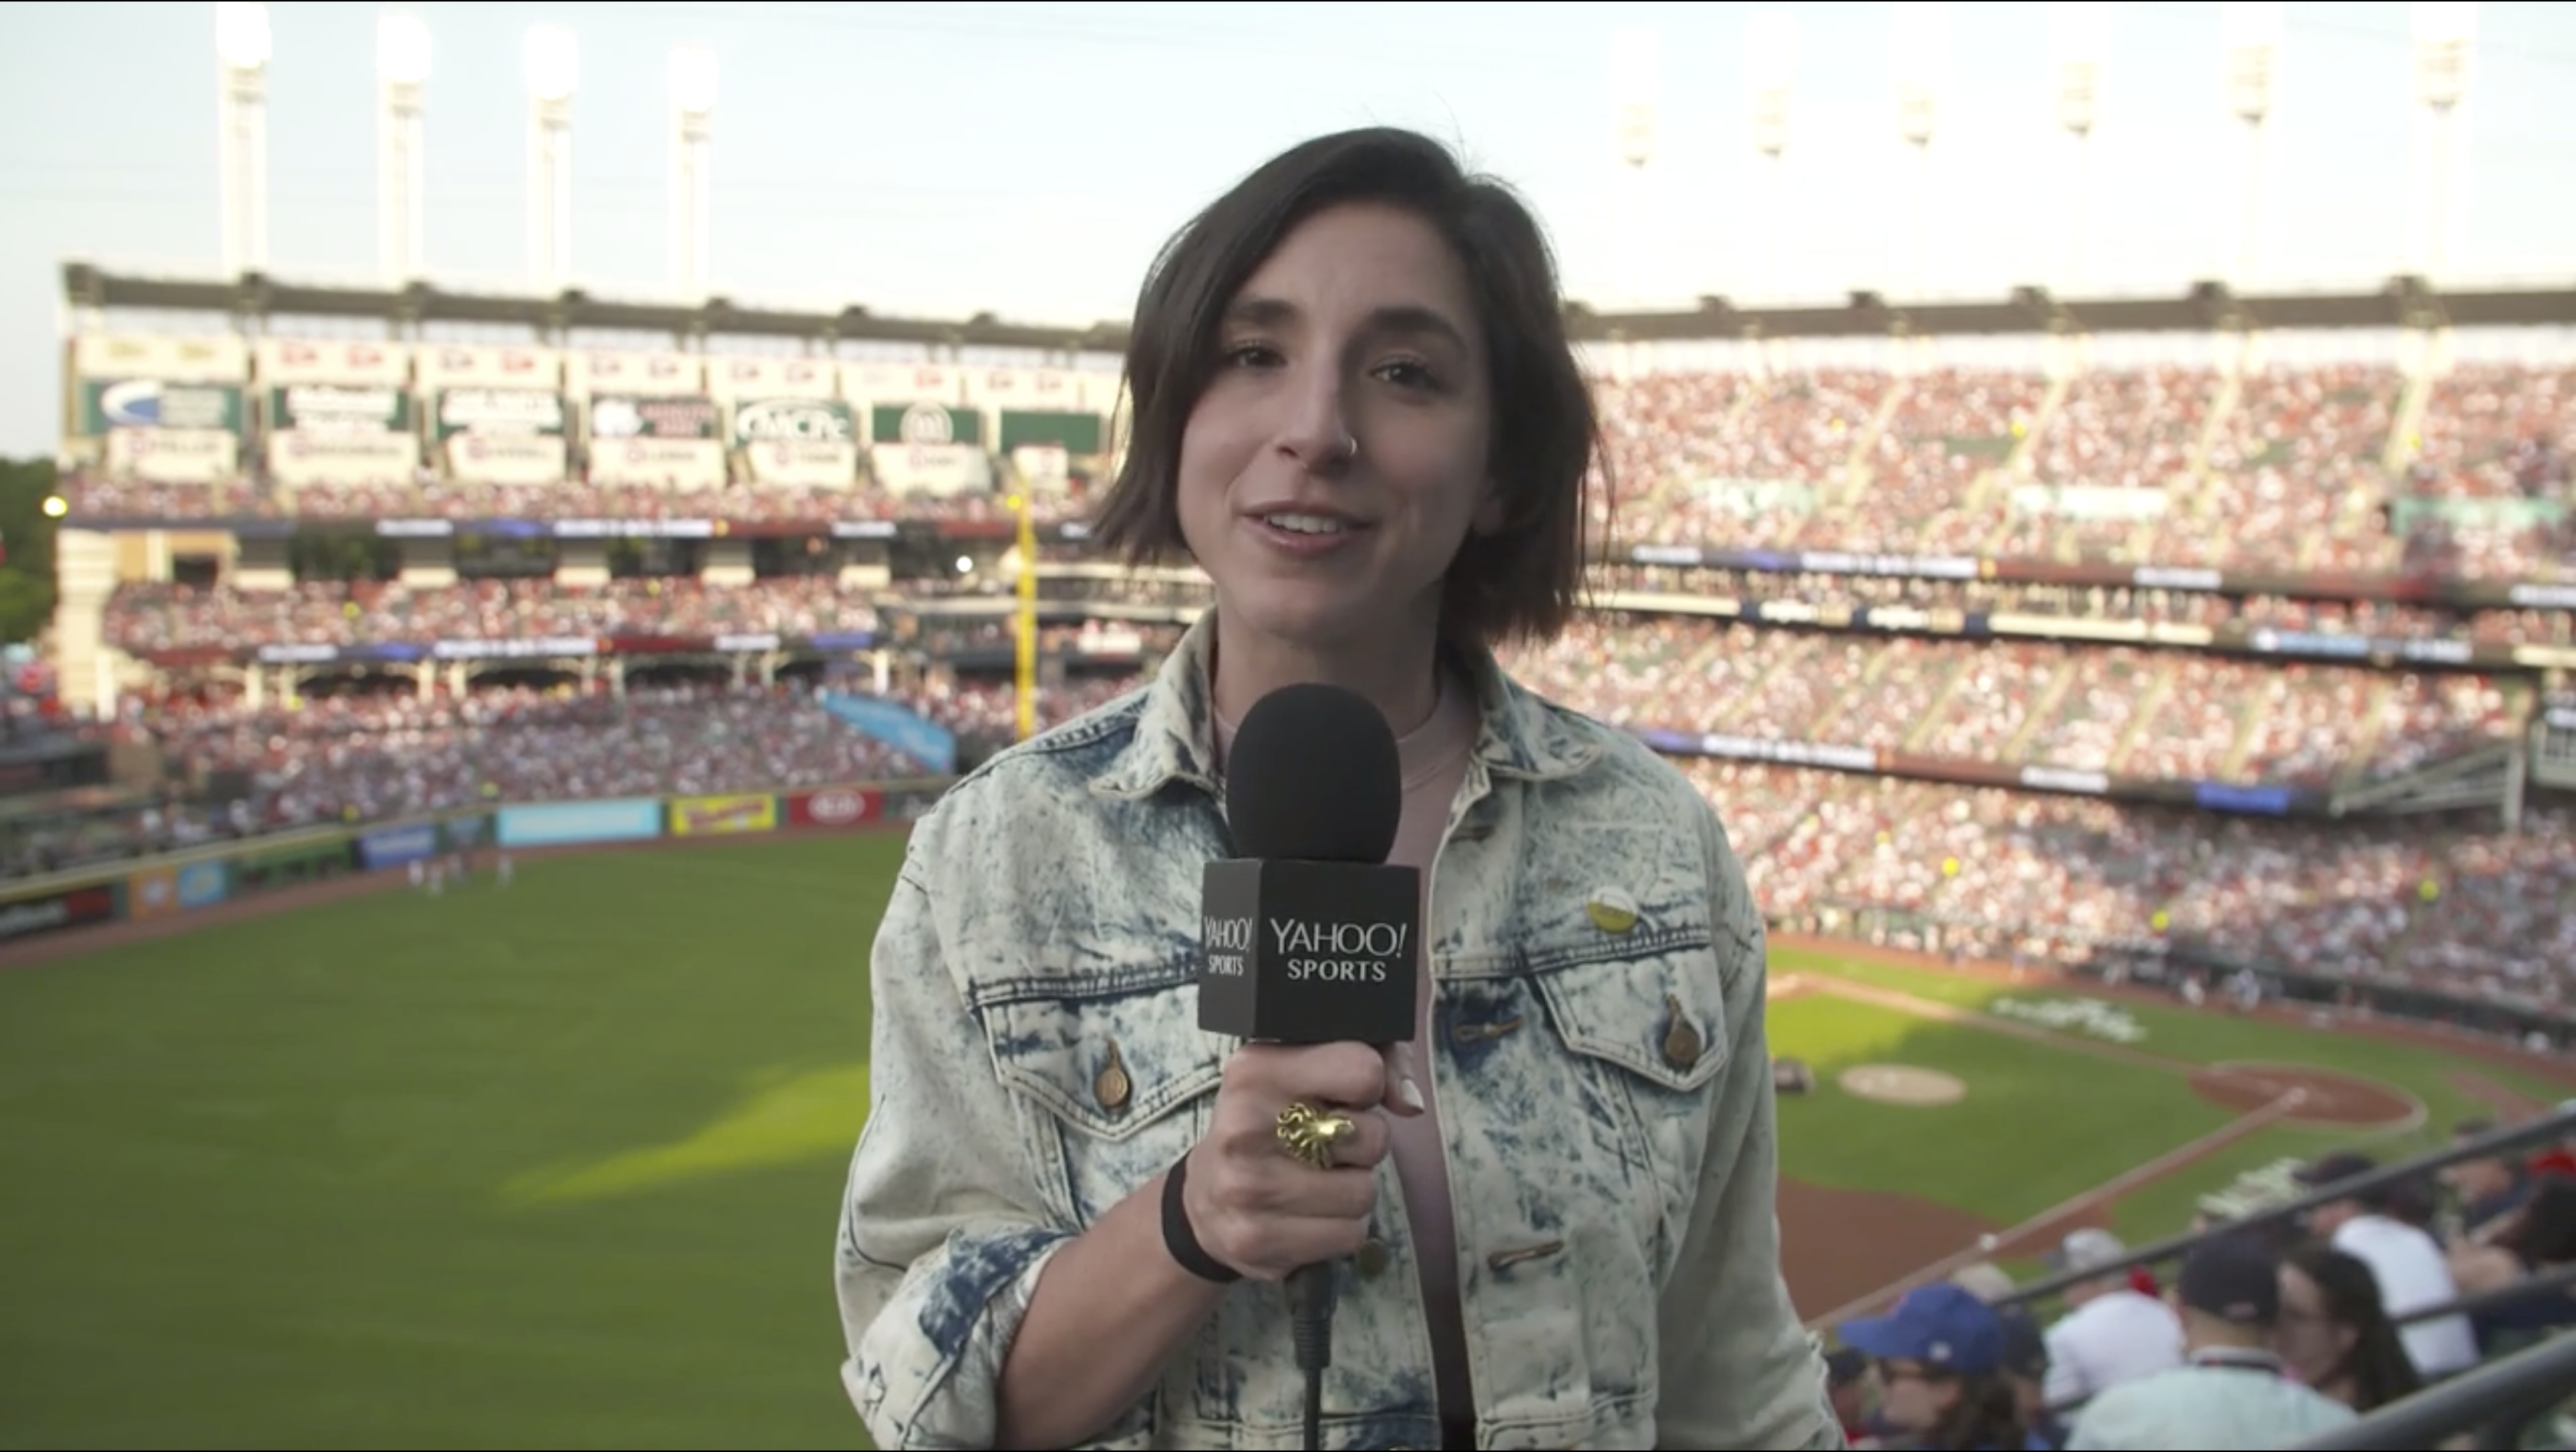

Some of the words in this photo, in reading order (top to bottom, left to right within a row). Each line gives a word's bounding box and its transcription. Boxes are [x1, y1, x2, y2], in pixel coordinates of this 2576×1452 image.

[1204, 917, 1253, 951] YAHOO!
[1270, 918, 1408, 958] YAHOO!
[1208, 955, 1244, 976] SPORTS
[1287, 958, 1386, 982] SPORTS
